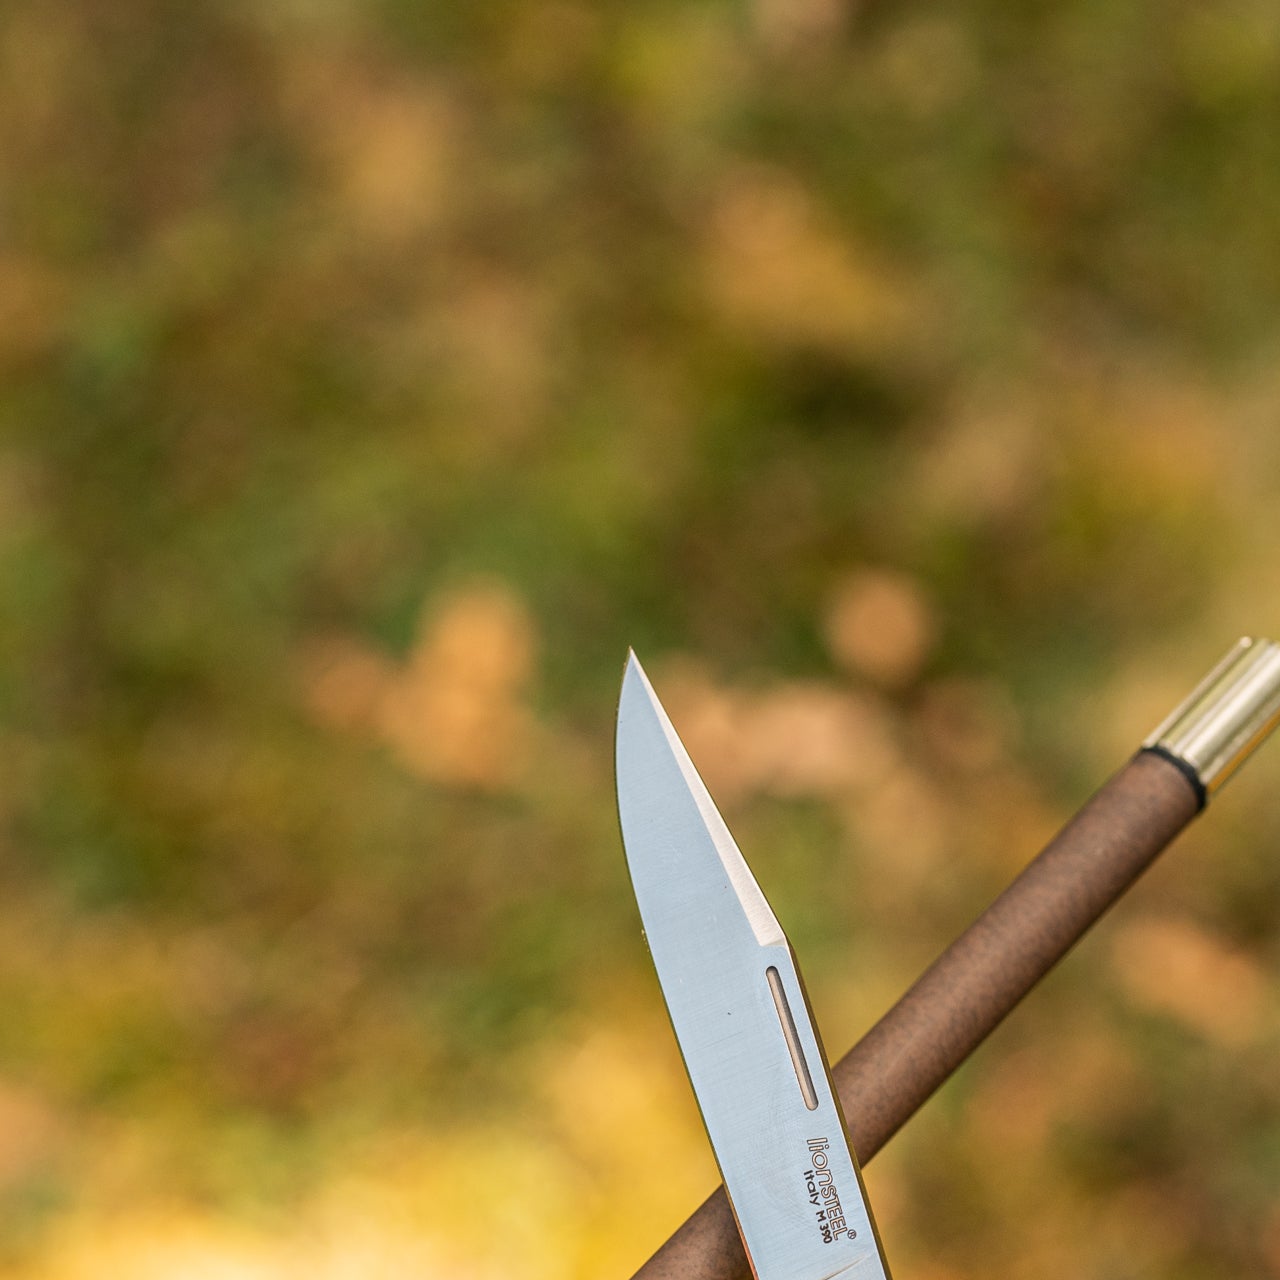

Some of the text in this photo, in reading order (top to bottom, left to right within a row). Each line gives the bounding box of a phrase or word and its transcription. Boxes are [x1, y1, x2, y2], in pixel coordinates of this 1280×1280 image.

[803, 1169, 833, 1244] Italy M 390
